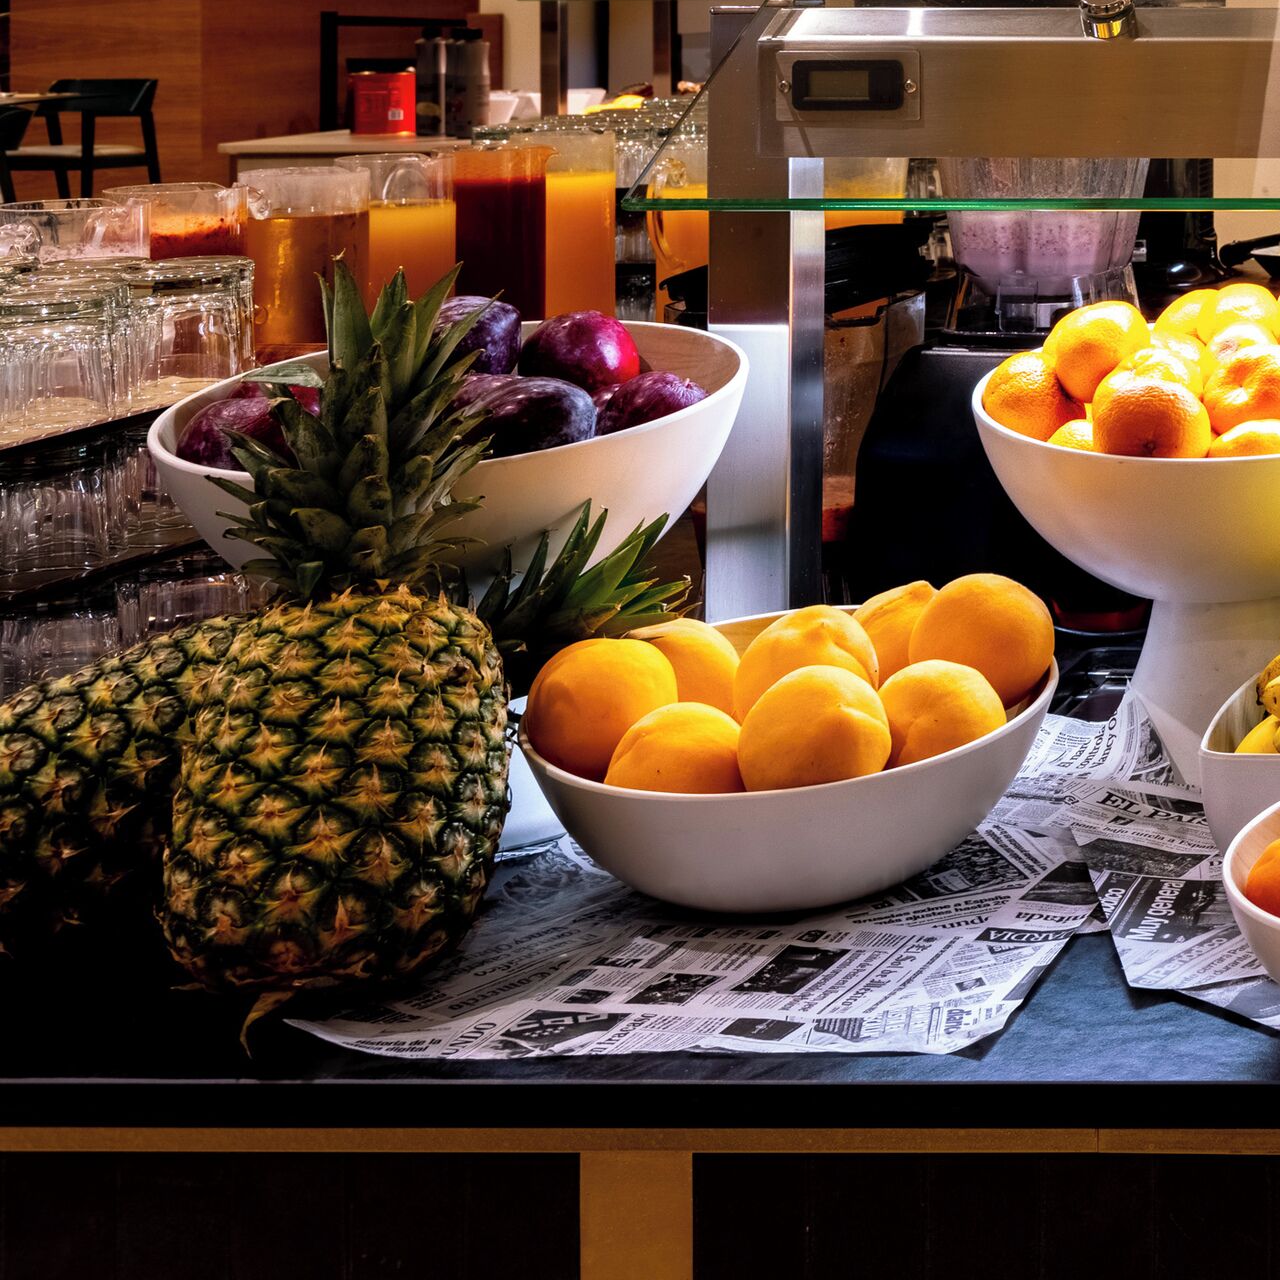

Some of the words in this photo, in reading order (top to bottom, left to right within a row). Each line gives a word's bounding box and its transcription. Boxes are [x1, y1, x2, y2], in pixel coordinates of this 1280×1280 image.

[1096, 791, 1142, 816] EL
[1125, 909, 1169, 941] Muy
[1151, 880, 1186, 922] general
[409, 1039, 427, 1047] de
[428, 1037, 442, 1046] la
